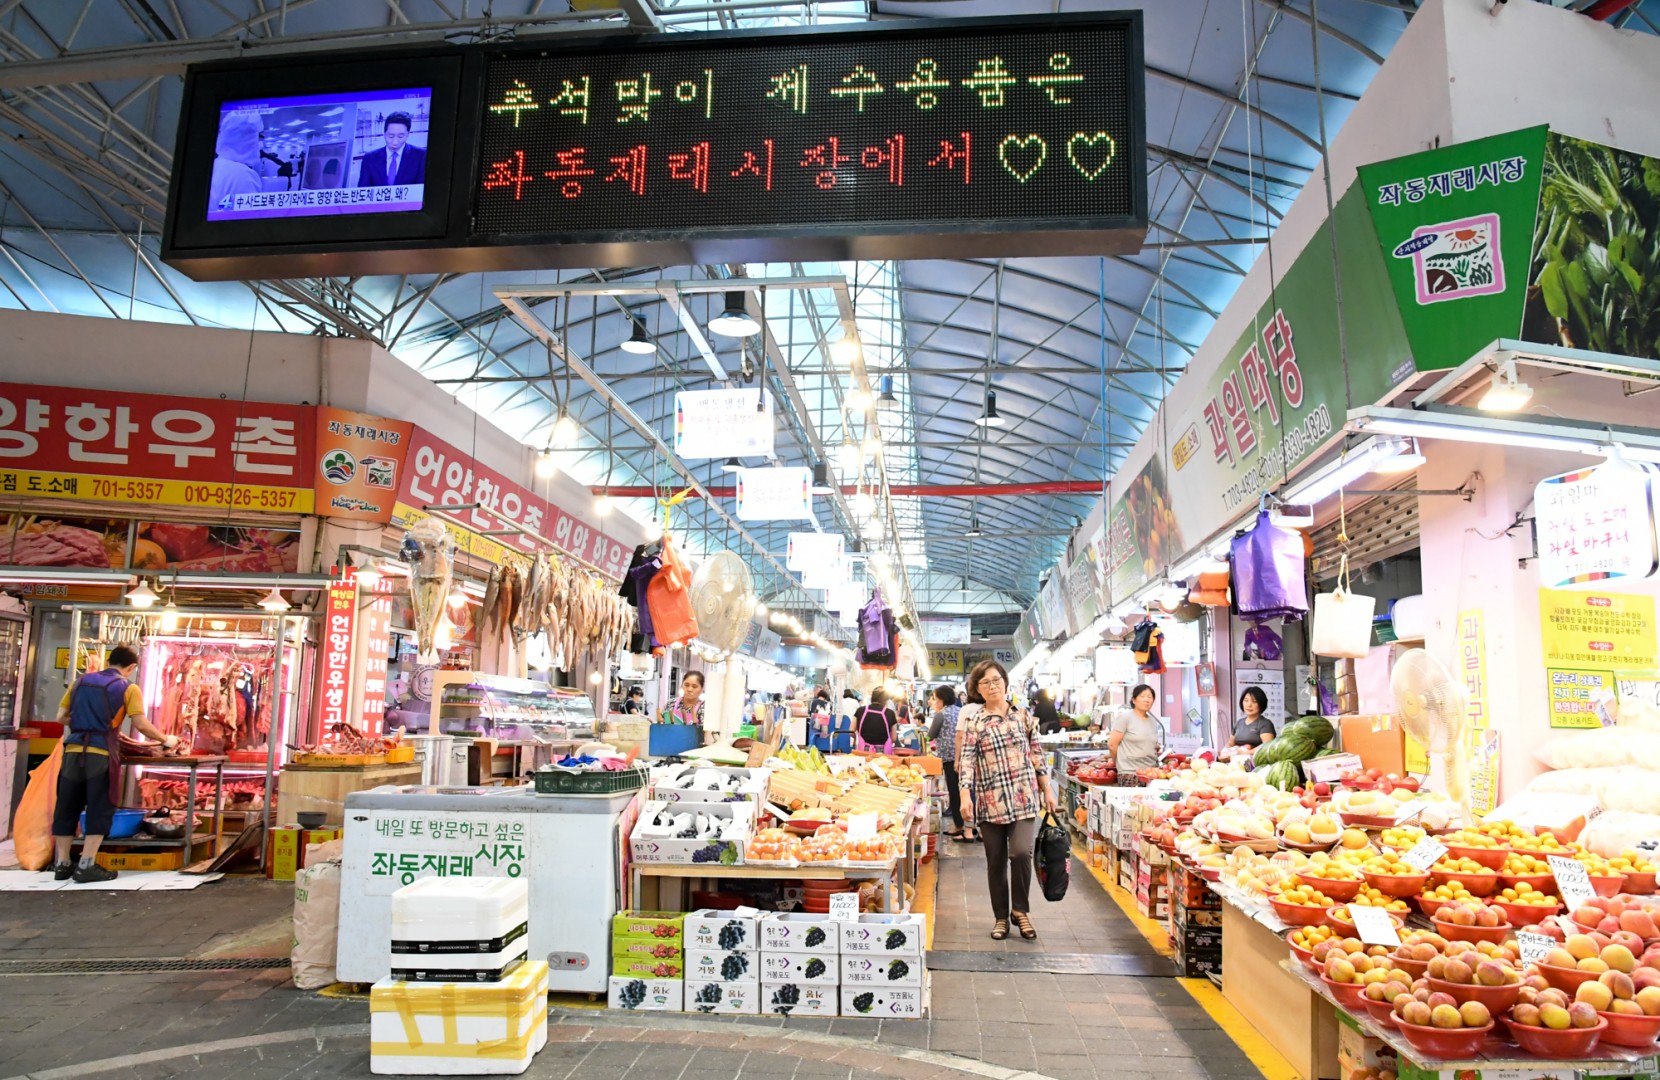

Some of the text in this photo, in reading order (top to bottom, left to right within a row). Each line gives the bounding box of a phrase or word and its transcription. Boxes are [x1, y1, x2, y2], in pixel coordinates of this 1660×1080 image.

[489, 53, 1084, 127] 추석 맞이 제수용품은
[483, 131, 971, 200] 좌동재래시장에서
[1379, 156, 1527, 206] 좌동재래시장
[236, 196, 244, 209] 中
[244, 194, 276, 208] 사드보복
[277, 192, 314, 207] 장기화에도
[317, 191, 333, 205] 영향
[333, 190, 349, 204] 없는
[351, 188, 374, 203] 반도체
[395, 187, 409, 201] 왜?
[1203, 308, 1304, 467] 과일마당
[328, 421, 400, 444] 좌동재래시장
[0, 473, 296, 508] 점 도.소매 701-5357 010-9326-5357
[410, 445, 544, 551] 언양한우촌
[1549, 528, 1630, 556] 과일 바구니
[334, 600, 350, 609] 한우
[1257, 673, 1263, 682] 9
[1552, 672, 1578, 686] 온누리
[1553, 687, 1589, 699] 전자 카드
[1554, 701, 1596, 714] 환영합니다
[376, 819, 404, 838] 내일
[410, 820, 424, 836] 또
[430, 821, 489, 839] 방문하고
[371, 843, 525, 887] 좌동재래시장
[696, 936, 713, 944] 거봉
[845, 942, 871, 950] 거봉포도
[698, 966, 715, 974] 거봉
[766, 971, 790, 979] 거봉포도
[848, 973, 872, 981] 거봉포도
